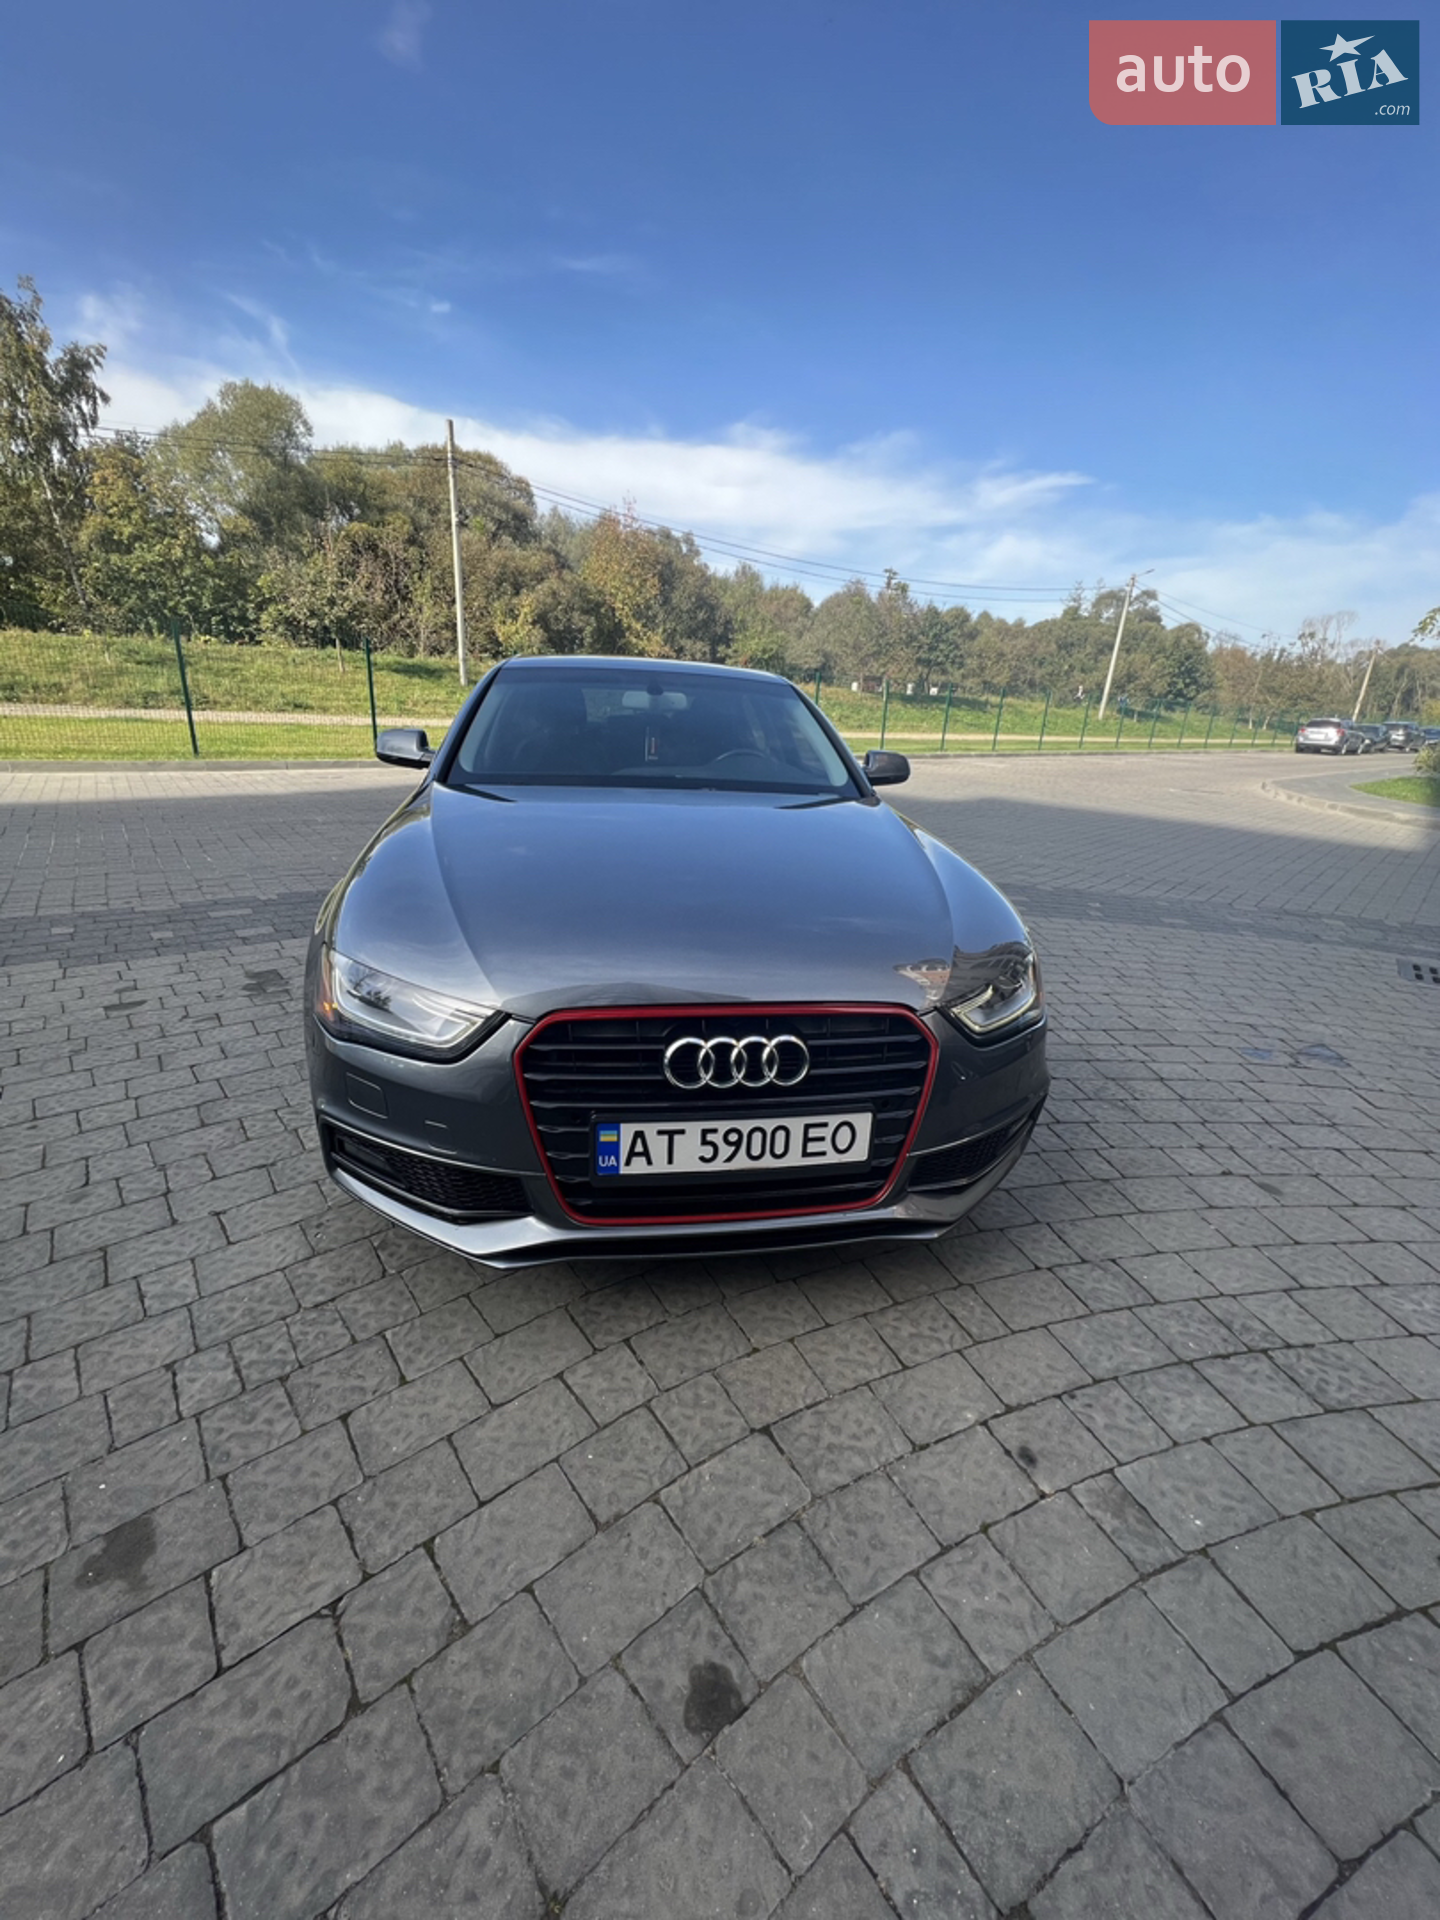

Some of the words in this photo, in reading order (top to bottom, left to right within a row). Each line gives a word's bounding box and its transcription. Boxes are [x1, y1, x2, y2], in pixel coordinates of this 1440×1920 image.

[624, 1129, 686, 1167] AT
[698, 1124, 790, 1164] 5900
[801, 1120, 857, 1158] EO
[598, 1155, 618, 1167] UA
